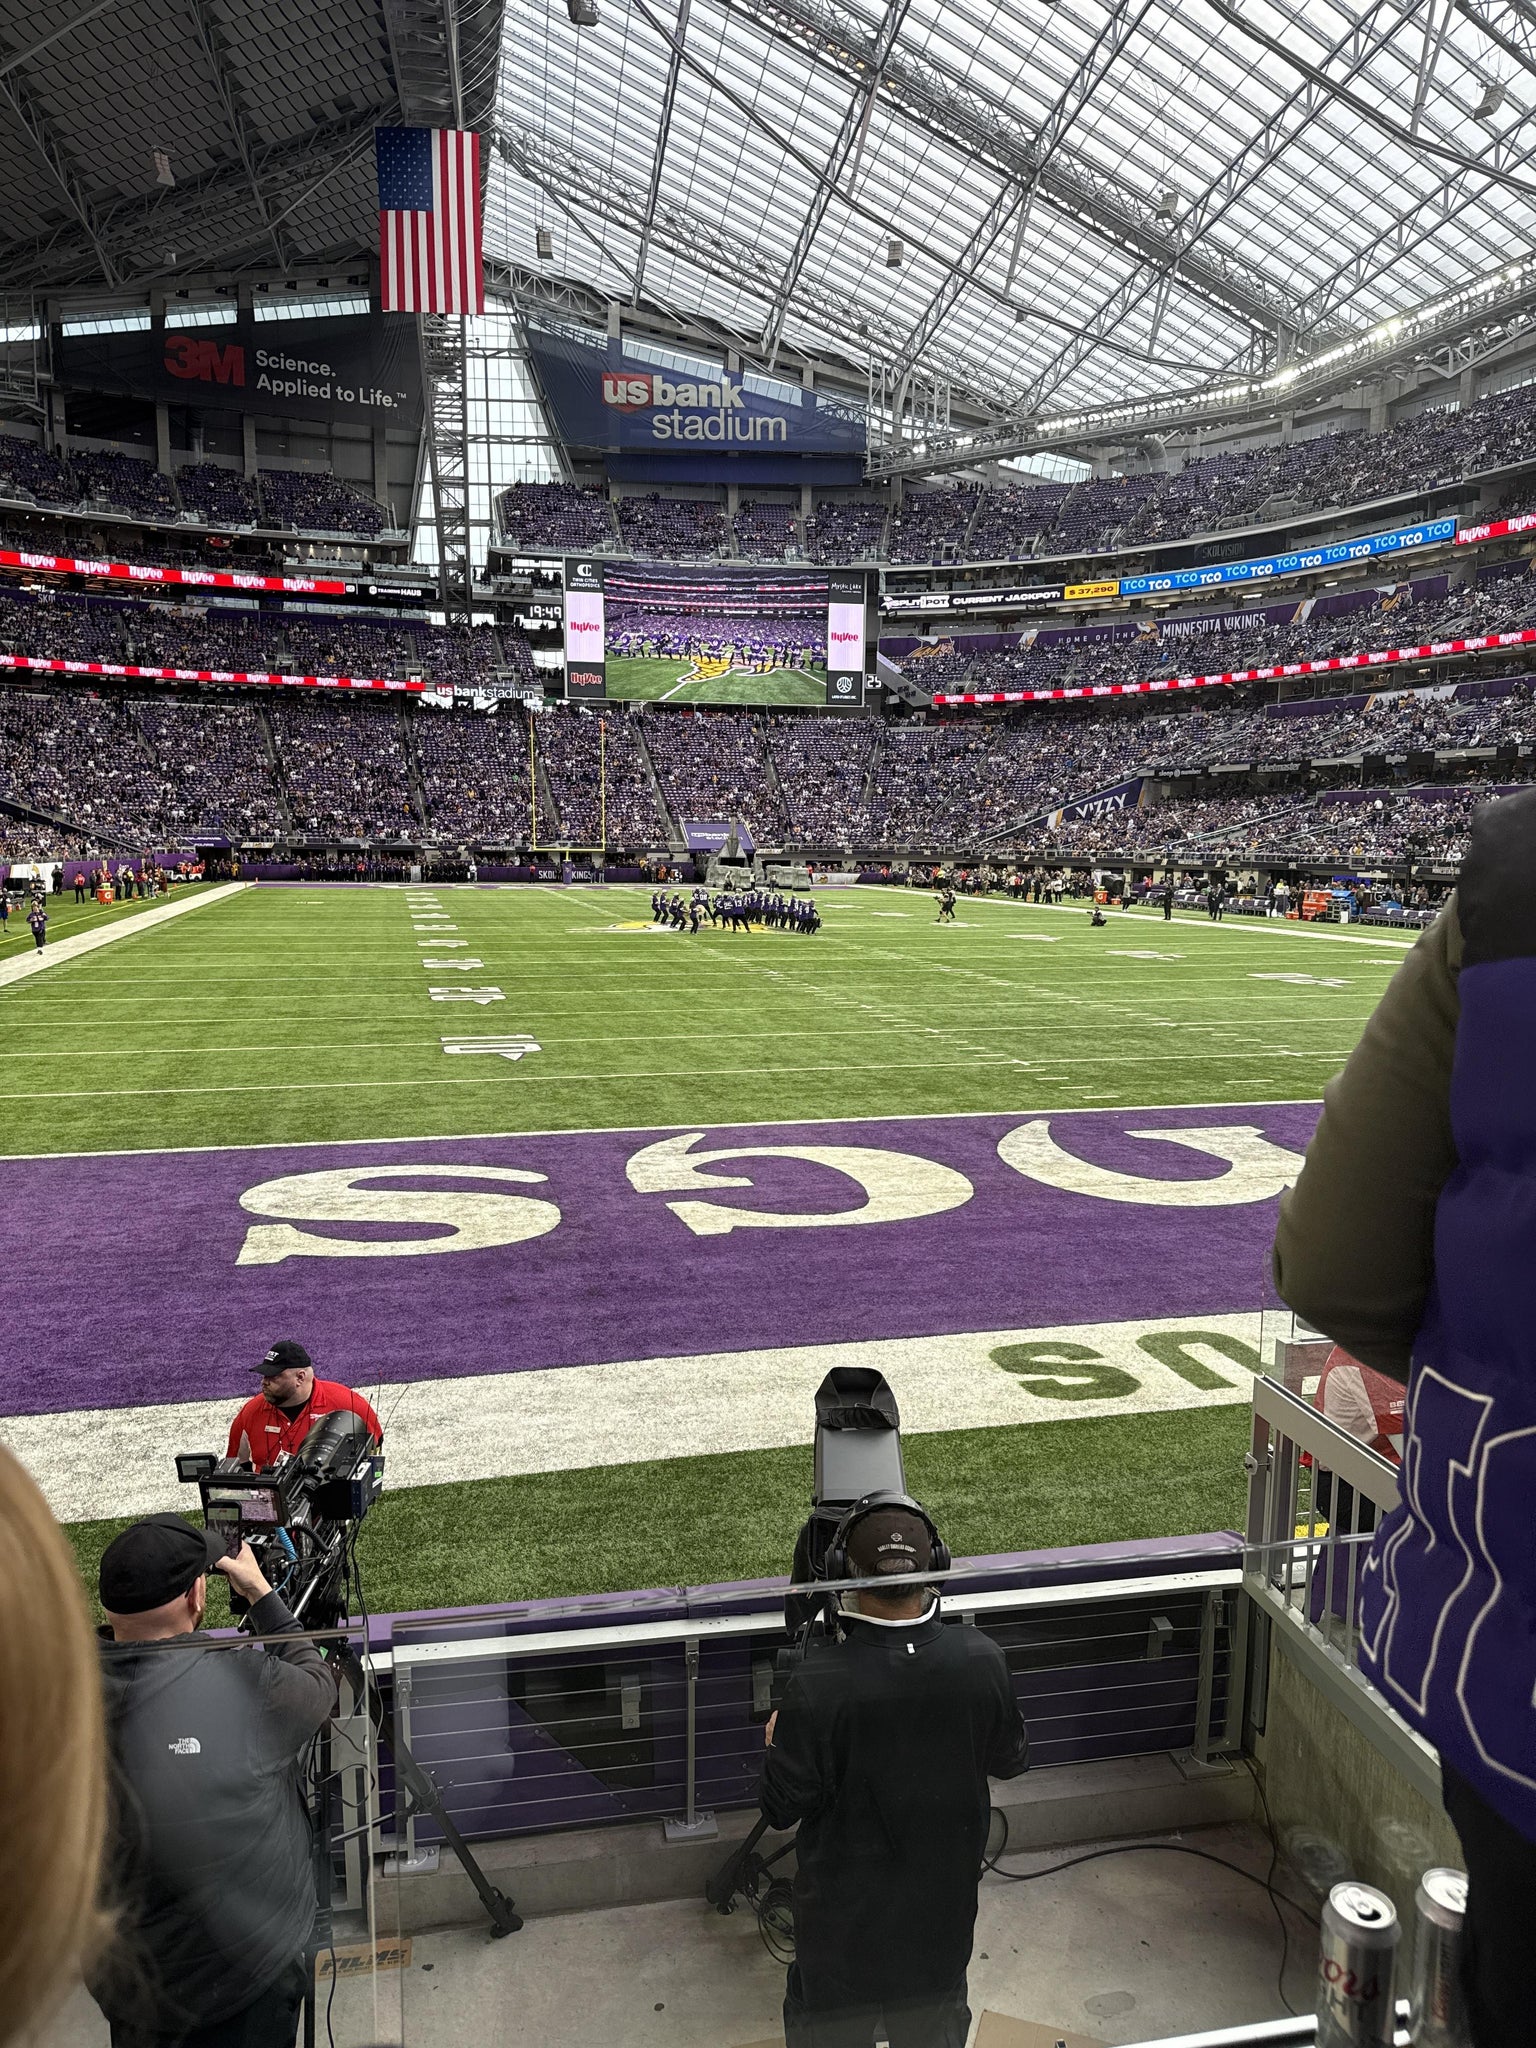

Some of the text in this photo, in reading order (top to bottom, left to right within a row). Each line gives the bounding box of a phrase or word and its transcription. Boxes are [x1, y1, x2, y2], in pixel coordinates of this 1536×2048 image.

[164, 335, 246, 386] 3M
[256, 350, 336, 377] Science.
[256, 374, 331, 399] Applied
[336, 386, 355, 402] to
[652, 408, 786, 441] stadium
[1124, 522, 1451, 590] TCO TCO TCO TCO TCO TCO TCO TCO TCO TCO TCO TCO TCO
[1202, 543, 1245, 558] SKOLVISION
[401, 588, 421, 597] HAUS
[1078, 586, 1114, 595] 37,290
[953, 595, 1004, 605] CURRENT
[530, 606, 562, 619] 19:49
[1163, 612, 1266, 638] MINNESOTA VIKINGS
[1058, 636, 1088, 644] HOME
[1116, 631, 1135, 639] THE
[867, 675, 881, 688] 25
[1075, 792, 1129, 818] VIZZY
[538, 870, 556, 879] SKOL
